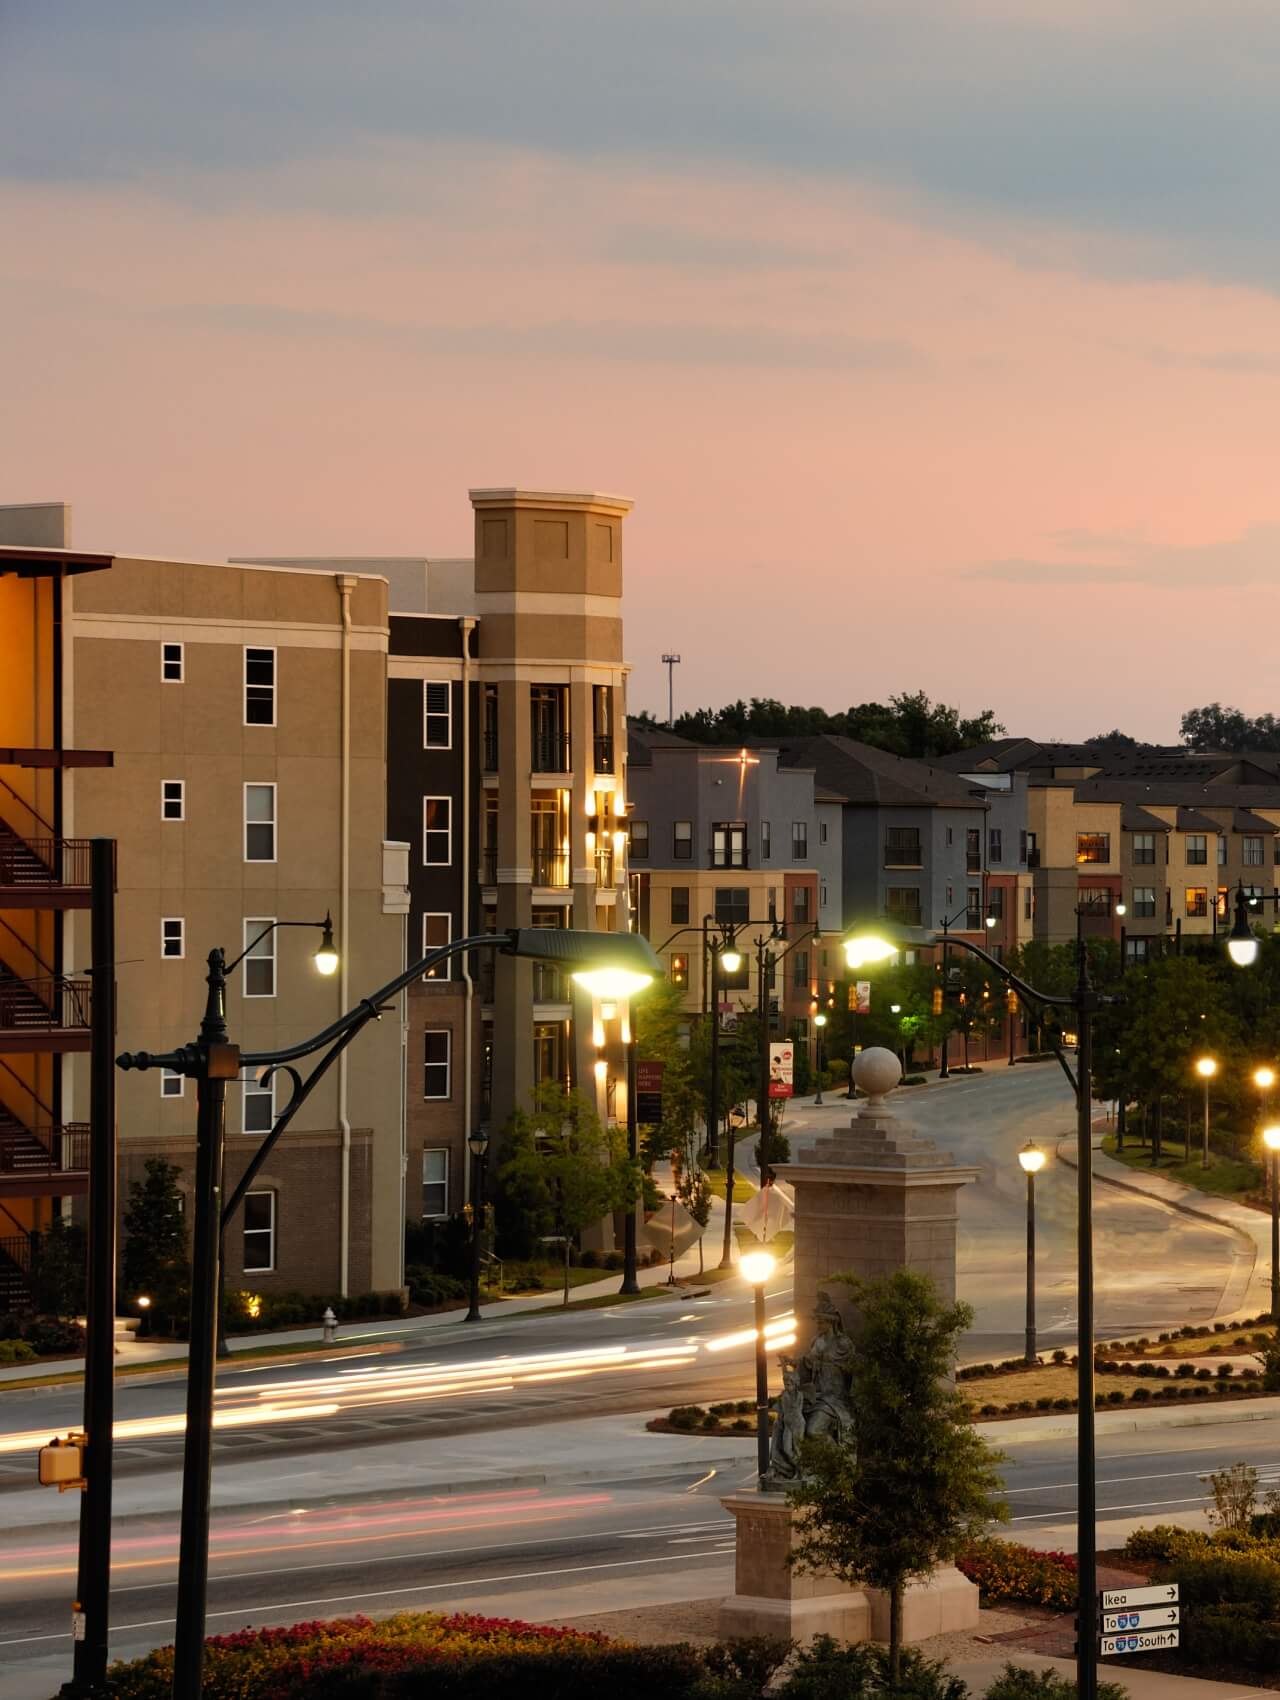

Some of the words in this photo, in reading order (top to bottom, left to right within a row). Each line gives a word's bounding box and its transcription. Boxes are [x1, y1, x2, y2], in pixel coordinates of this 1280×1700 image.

[1105, 1595, 1127, 1606] Ikea
[1106, 1618, 1116, 1629] To
[1104, 1640, 1115, 1652] To
[1139, 1635, 1166, 1648] South
